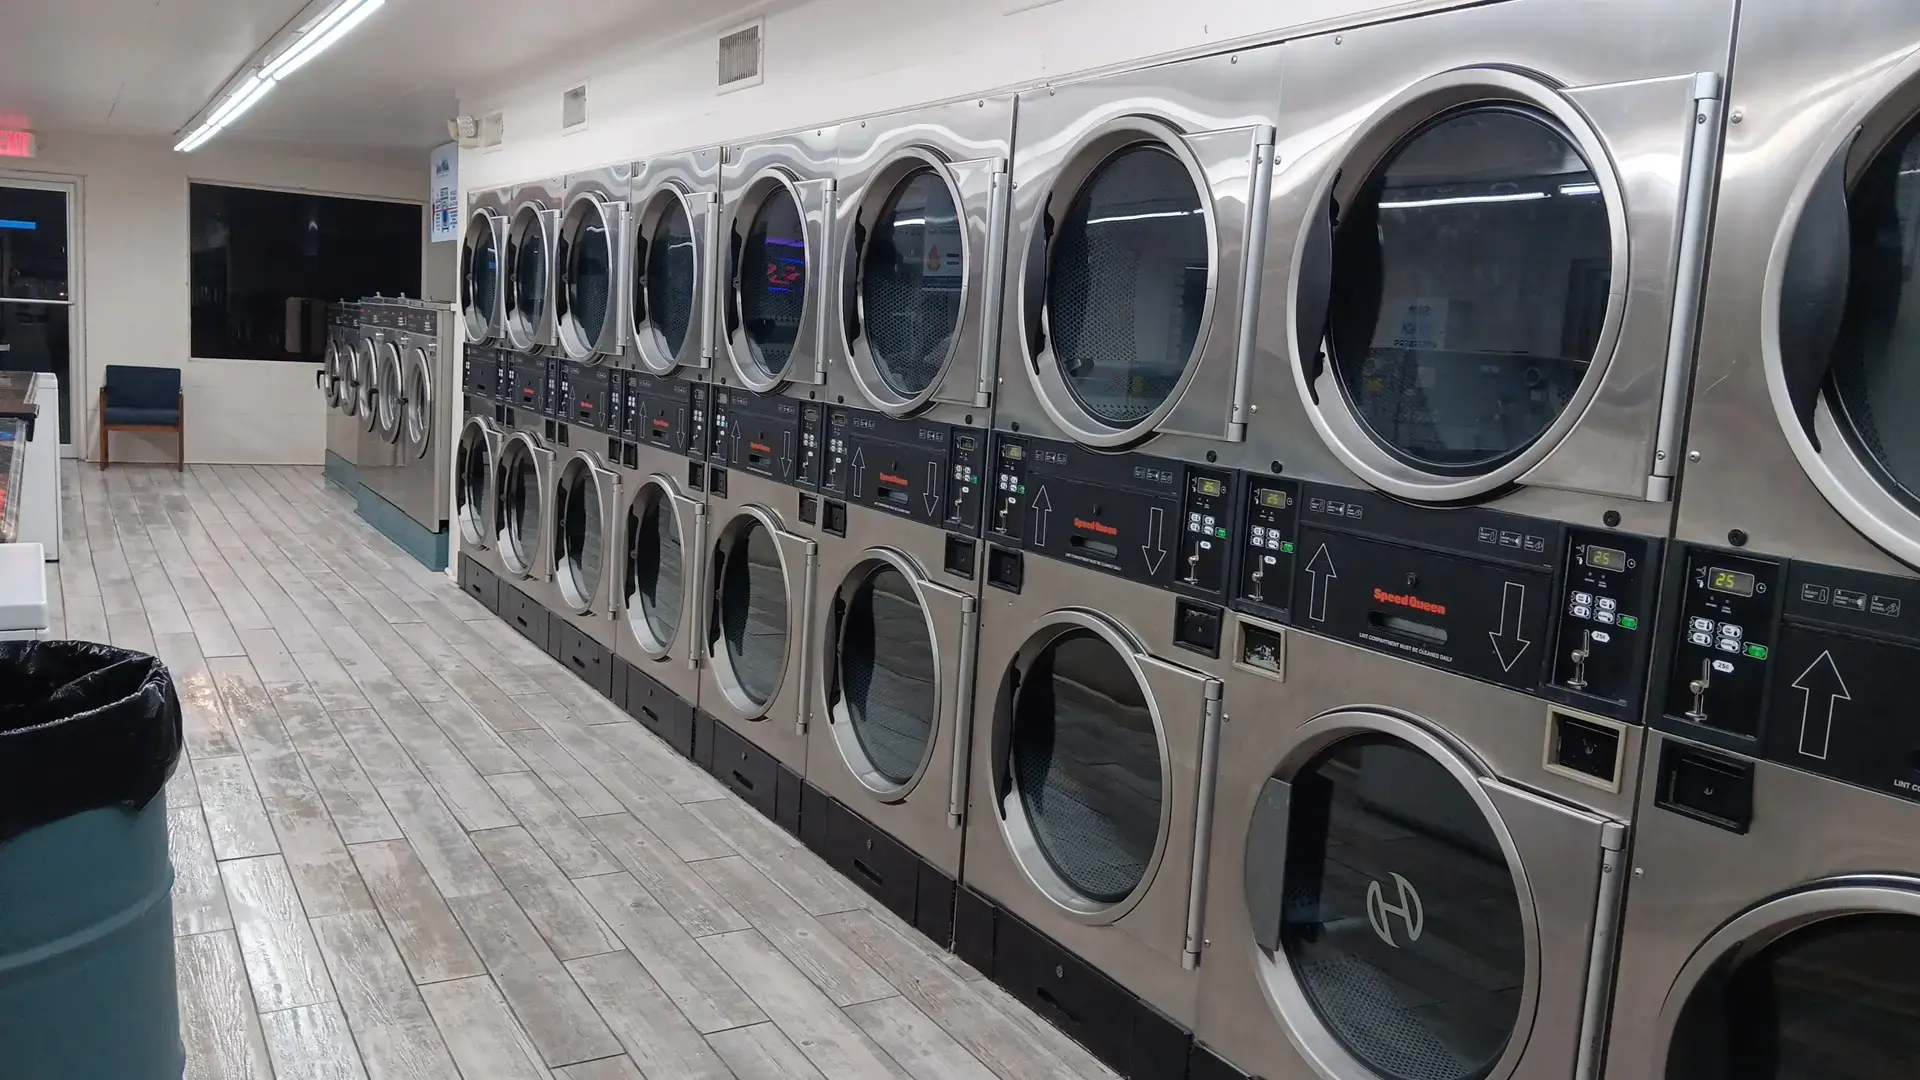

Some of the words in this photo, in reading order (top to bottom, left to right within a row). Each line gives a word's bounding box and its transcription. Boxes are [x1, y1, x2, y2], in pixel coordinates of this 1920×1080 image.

[1594, 551, 1610, 565] 25
[1716, 573, 1735, 588] 25
[1373, 588, 1408, 606] Speed
[1409, 596, 1446, 615] Queen
[1894, 779, 1911, 789] LINT
